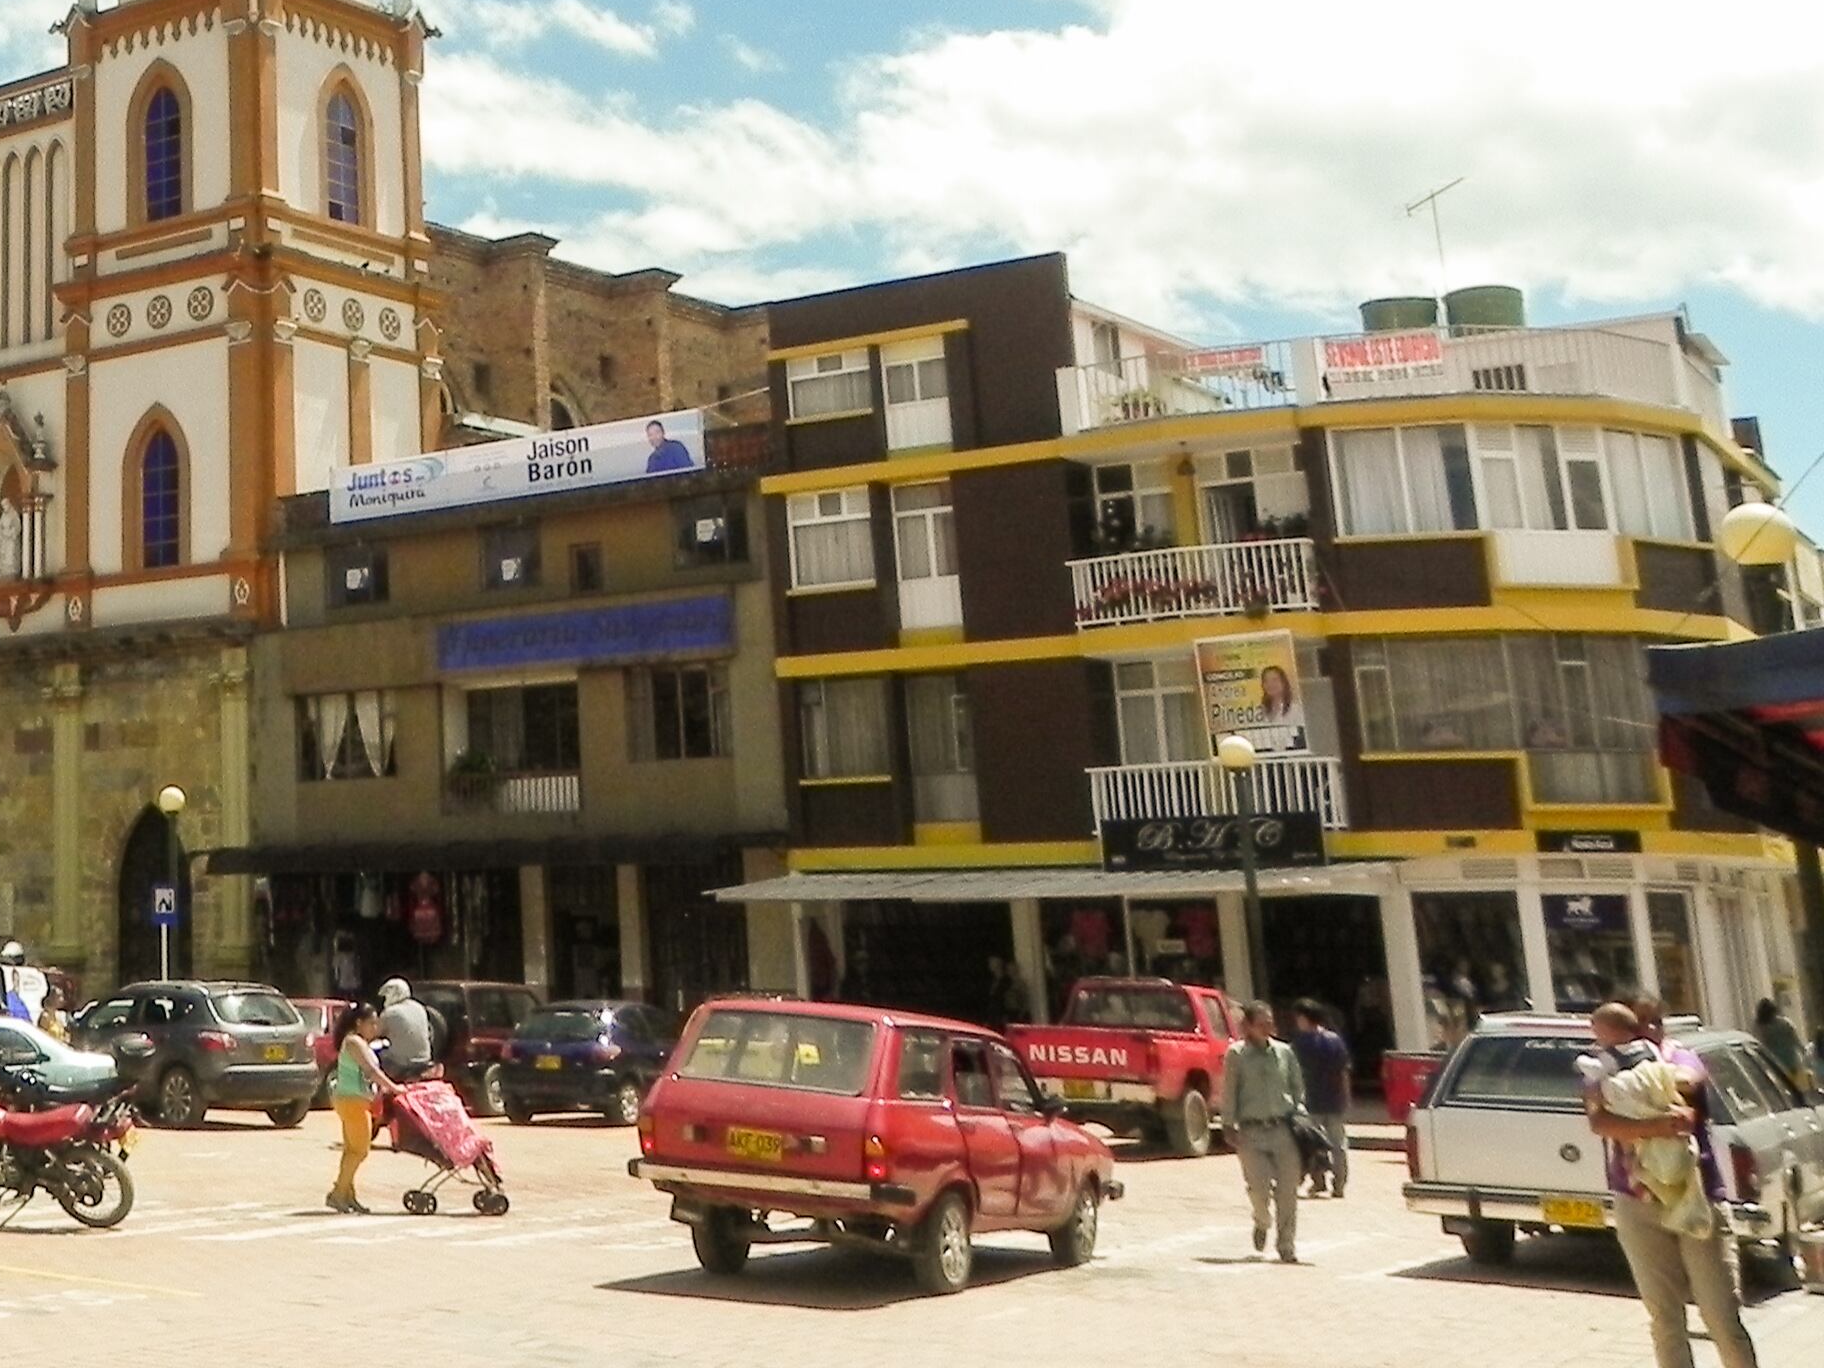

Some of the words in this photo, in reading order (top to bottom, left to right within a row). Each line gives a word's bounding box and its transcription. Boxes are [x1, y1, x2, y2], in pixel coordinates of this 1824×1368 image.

[526, 435, 589, 461] Jaison
[528, 456, 592, 482] Barón
[1212, 702, 1264, 724] Pineda
[1029, 1043, 1128, 1066] NISSAN
